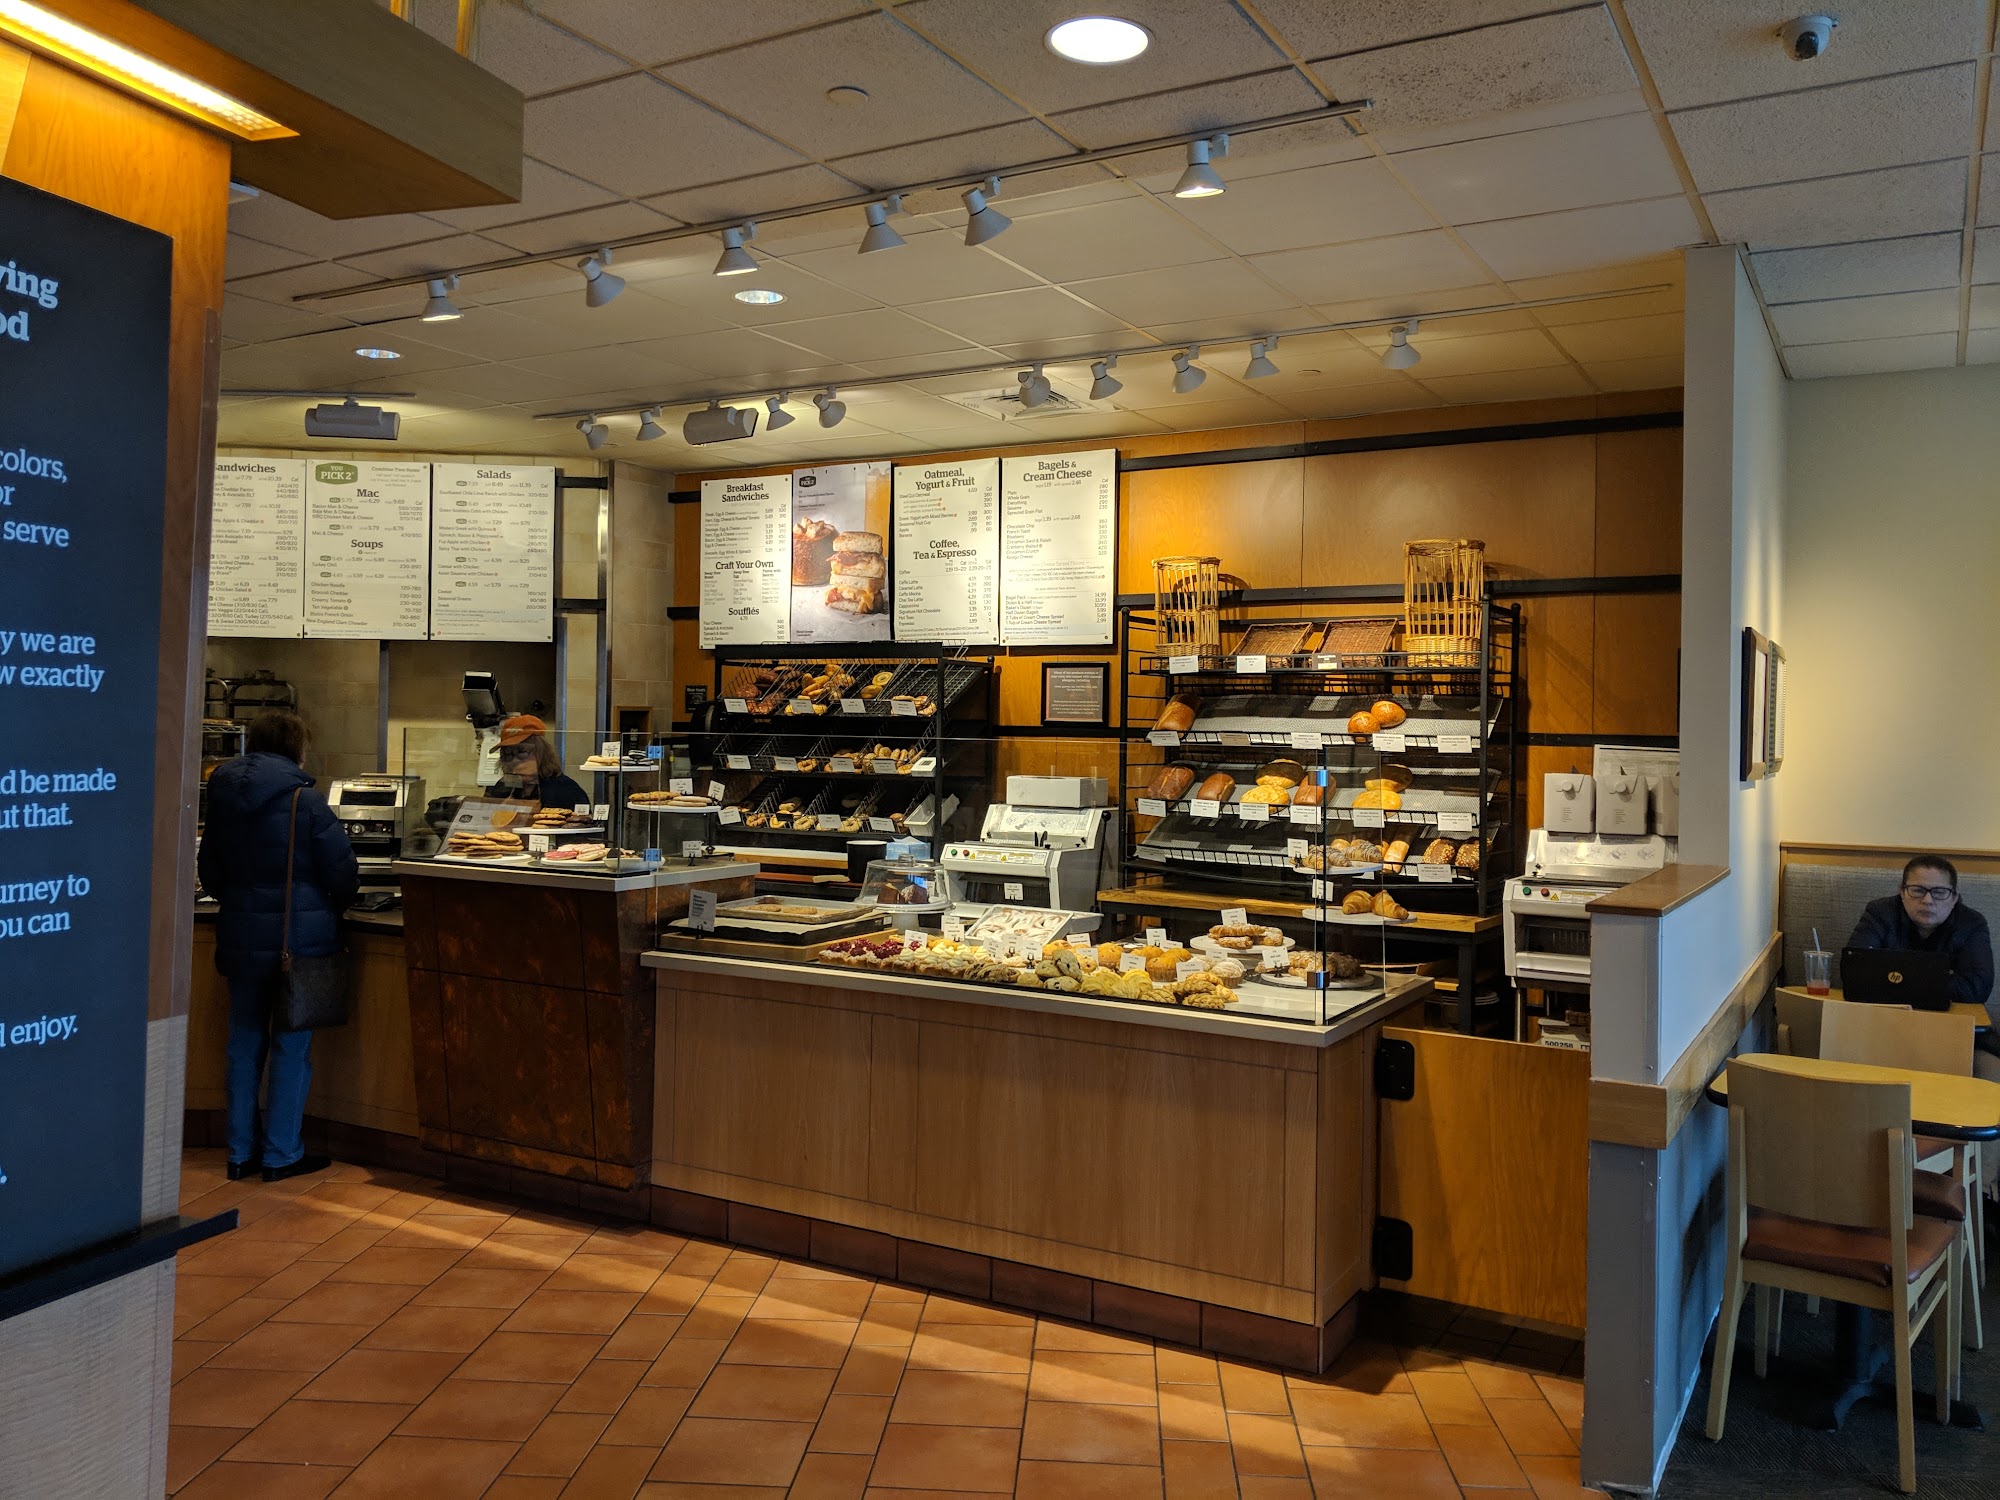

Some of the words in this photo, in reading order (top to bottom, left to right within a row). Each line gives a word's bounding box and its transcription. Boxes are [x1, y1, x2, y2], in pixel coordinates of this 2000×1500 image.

[0, 448, 67, 483] olors,
[1038, 460, 1070, 471] Bagels
[321, 472, 344, 480] PICK
[477, 470, 512, 479] Salads
[924, 468, 965, 479] Oatmeal,
[1024, 472, 1055, 482] Cream
[1057, 470, 1092, 479] Cheese
[727, 483, 764, 493] Breakfast
[916, 480, 944, 491] Yogurt
[952, 477, 975, 486] Fruit
[357, 489, 379, 497] Mac
[722, 493, 769, 502] Sandwiches
[3, 520, 70, 547] serve
[351, 540, 383, 549] Soups
[930, 540, 959, 549] Coffee,
[913, 551, 929, 560] Tea
[937, 549, 977, 559] Espresso
[716, 562, 734, 570] Craft
[755, 560, 774, 568] Own
[729, 607, 759, 616] Soufflés
[20, 632, 56, 653] we
[59, 635, 96, 655] are
[20, 664, 105, 692] exactly
[20, 770, 50, 795] be
[53, 768, 116, 793] made
[23, 803, 73, 828] that.
[67, 875, 90, 898] to
[28, 912, 70, 934] can
[11, 1012, 78, 1046] enjoy.
